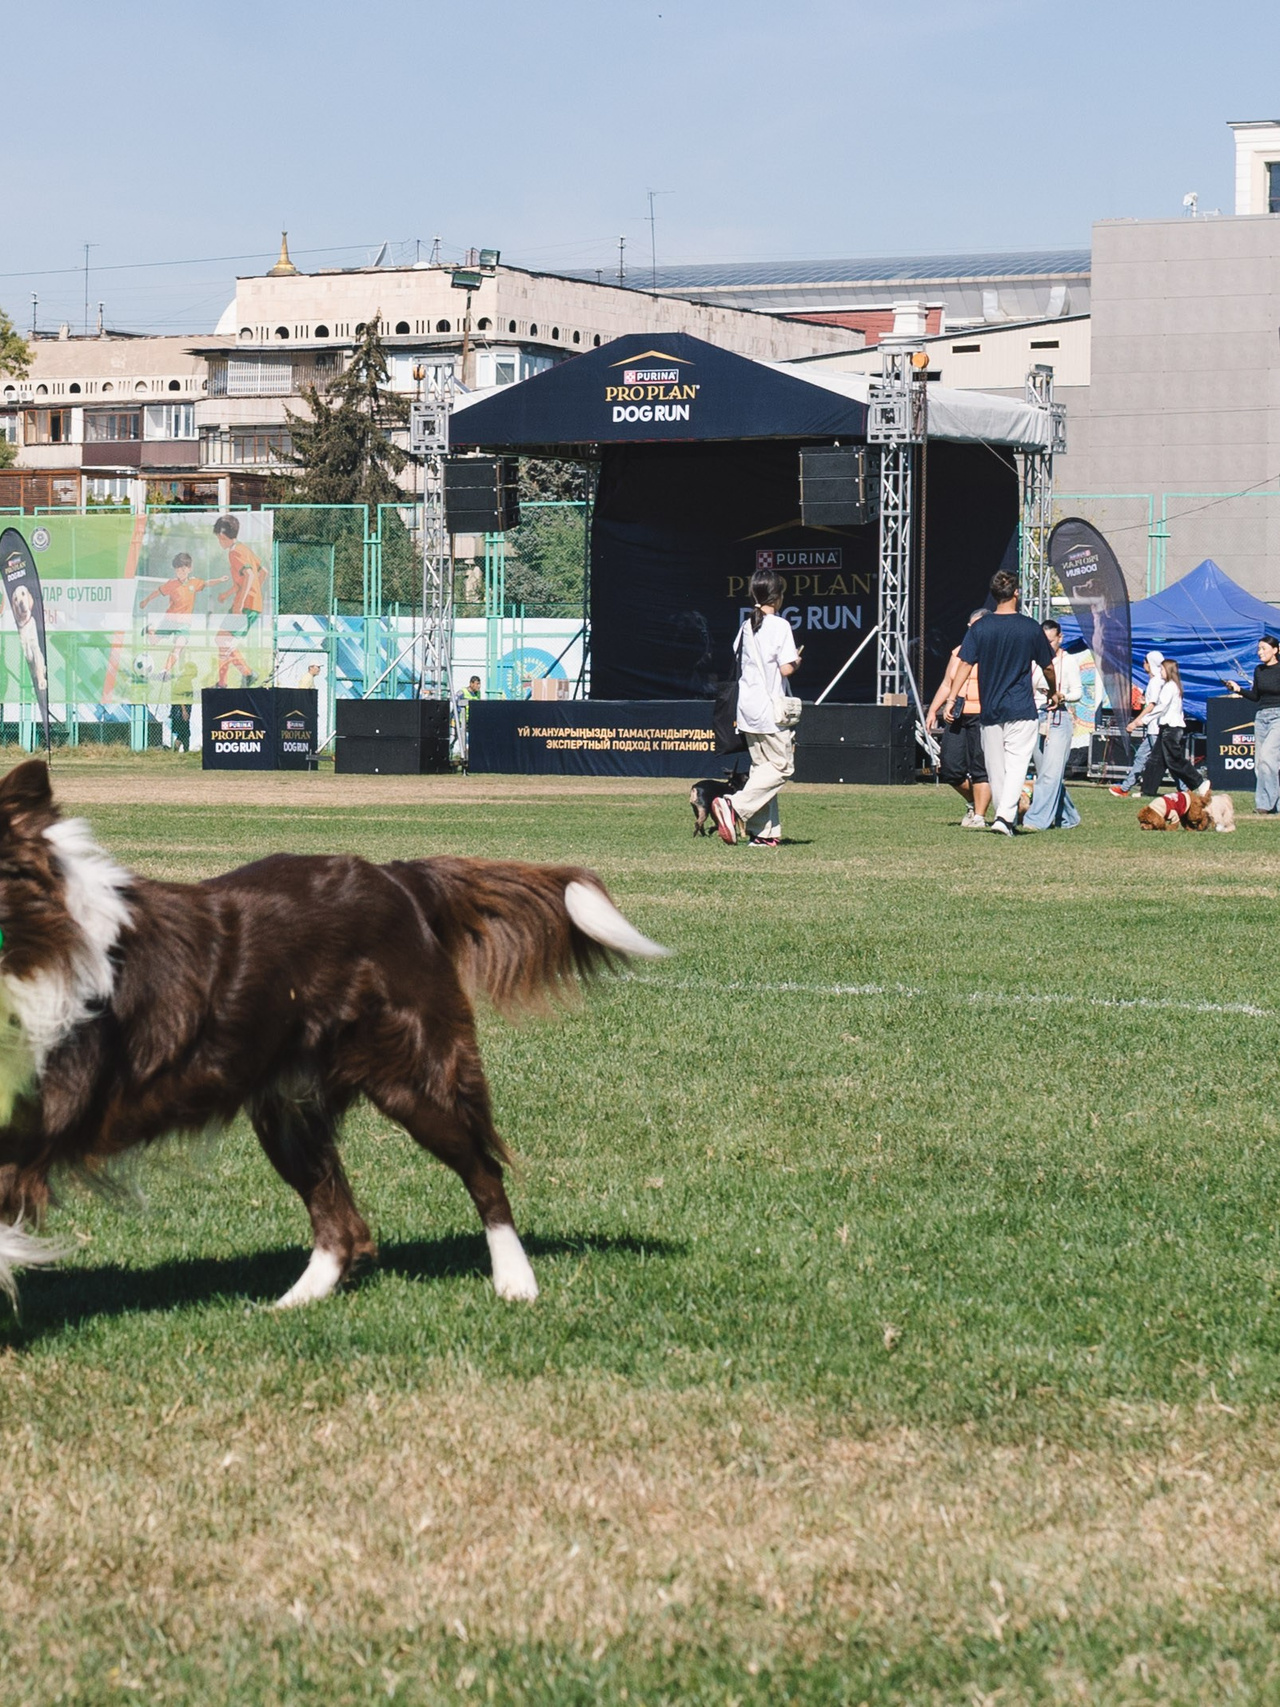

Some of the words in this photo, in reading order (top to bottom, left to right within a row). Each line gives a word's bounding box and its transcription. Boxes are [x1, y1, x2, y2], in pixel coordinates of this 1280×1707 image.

[636, 371, 676, 381] PURINA
[605, 385, 645, 402] PRO
[646, 384, 696, 400] PLAN
[612, 405, 653, 423] DOG
[654, 404, 690, 422] RUN
[776, 552, 838, 565] PURINA
[792, 573, 871, 596] PLAN
[67, 586, 112, 602] ФУТБОЛ
[807, 605, 862, 630] RUN
[211, 730, 235, 740] PRO
[235, 730, 265, 740] PLAN
[215, 742, 240, 753] DOG
[240, 742, 261, 753] RUN
[283, 742, 297, 752] DOG
[297, 742, 309, 752] RUN
[545, 737, 611, 750] ЭКСПЕРТНЫЙ
[612, 740, 651, 752] ПОДХОД
[652, 741, 660, 750] К
[661, 741, 708, 751] ПИТАНИЮ
[1219, 745, 1248, 756] PRO
[1224, 757, 1255, 770] DOG
